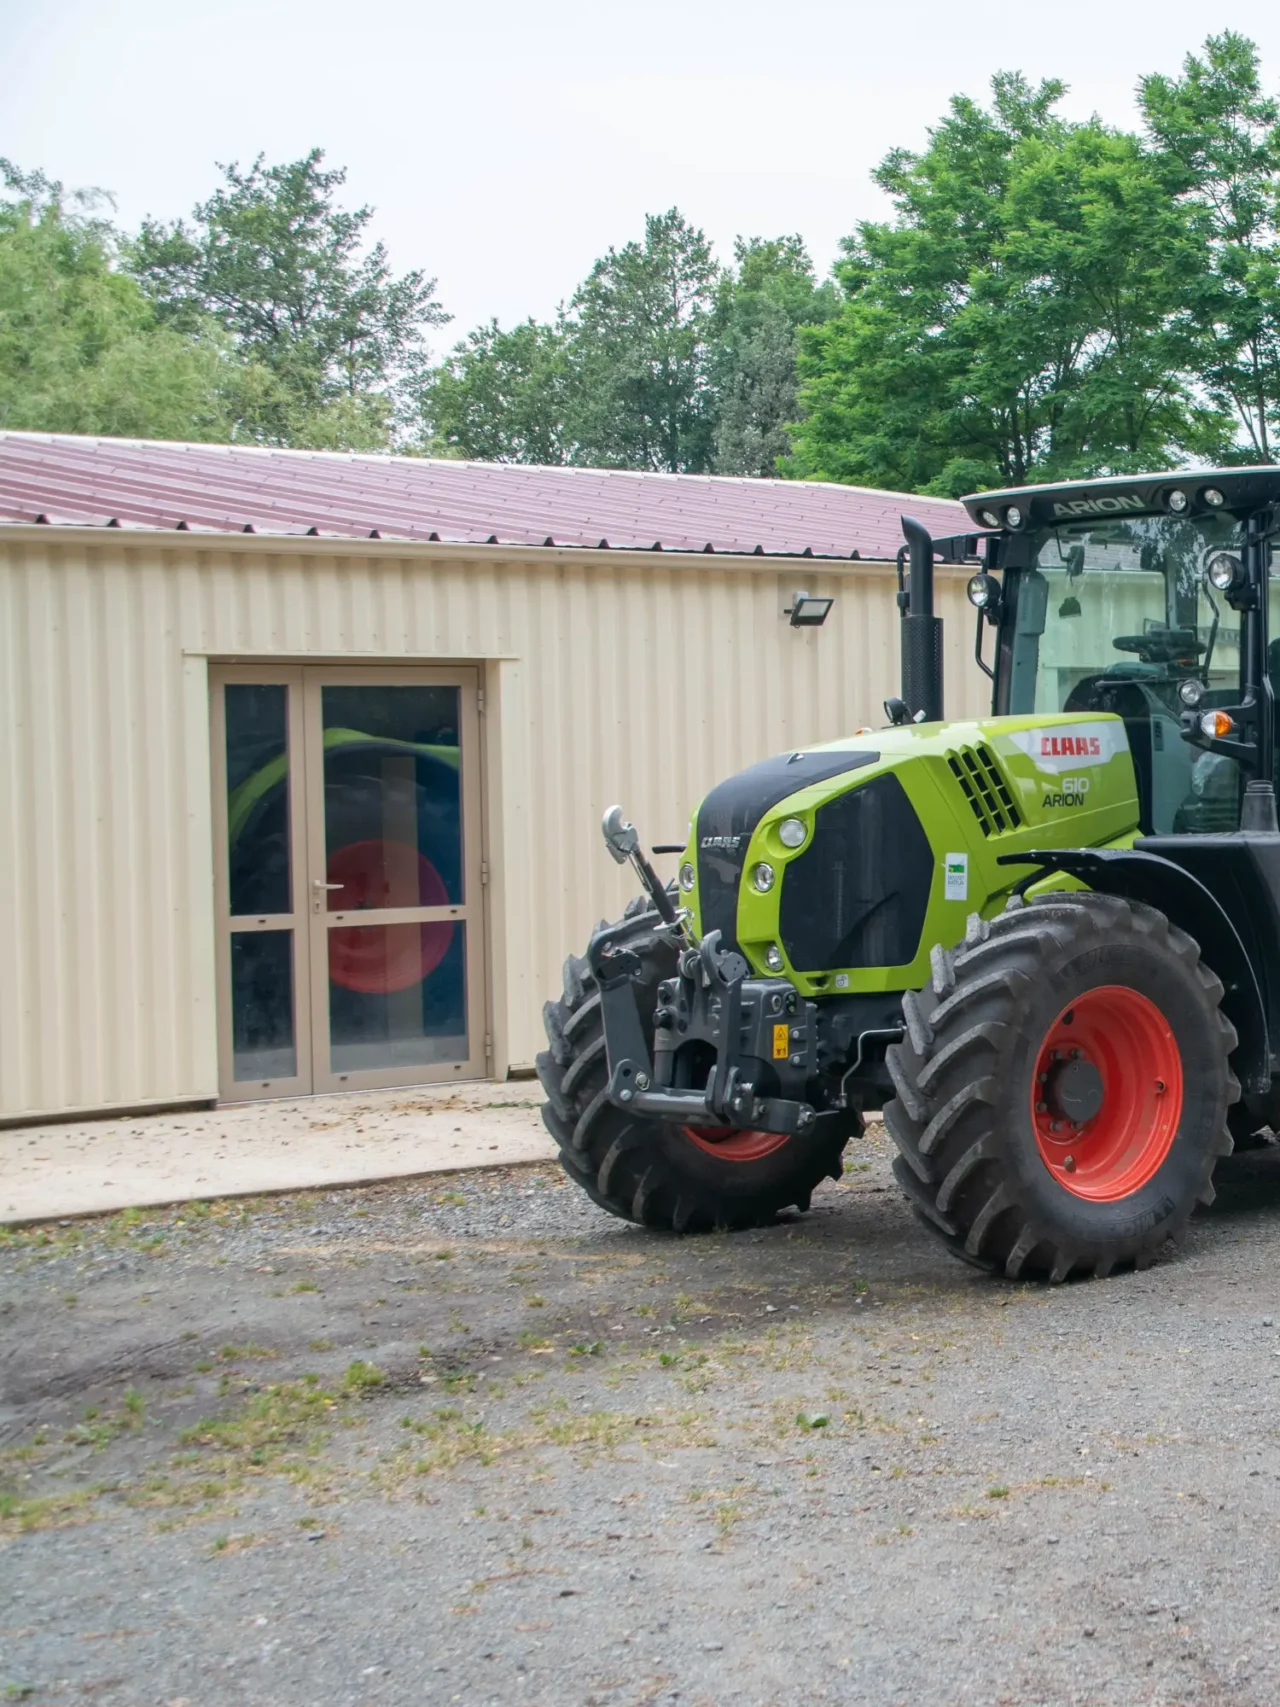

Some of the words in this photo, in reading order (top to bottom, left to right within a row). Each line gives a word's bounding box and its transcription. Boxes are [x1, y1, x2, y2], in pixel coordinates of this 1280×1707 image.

[1053, 495, 1145, 516] ARION
[1041, 736, 1101, 756] CLAAS
[1062, 777, 1090, 793] 610
[1042, 792, 1085, 807] ARION
